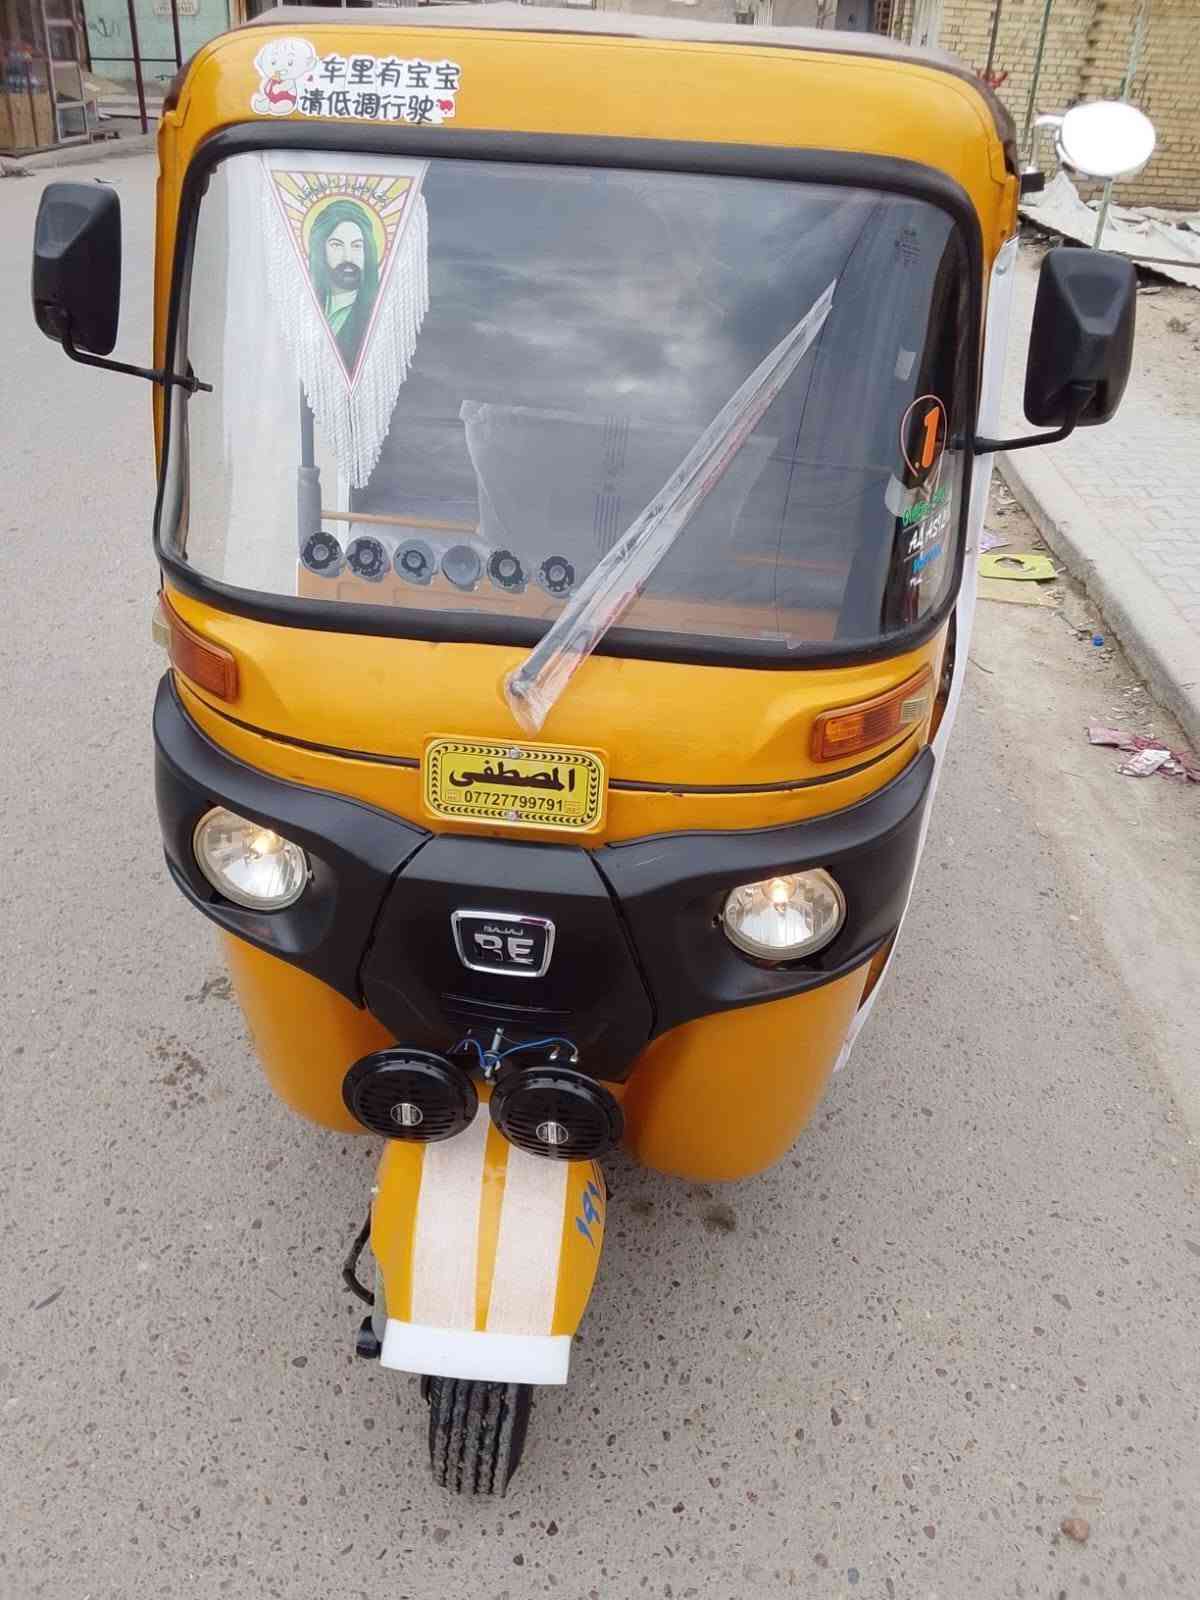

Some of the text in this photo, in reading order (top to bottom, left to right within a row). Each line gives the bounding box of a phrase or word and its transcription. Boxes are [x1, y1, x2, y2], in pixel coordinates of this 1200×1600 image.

[319, 57, 461, 91] 车里有宝宝
[300, 88, 435, 122] 请低调行驶
[449, 760, 576, 793] المصطفى
[464, 790, 563, 812] 07727799791
[474, 933, 535, 965] RE
